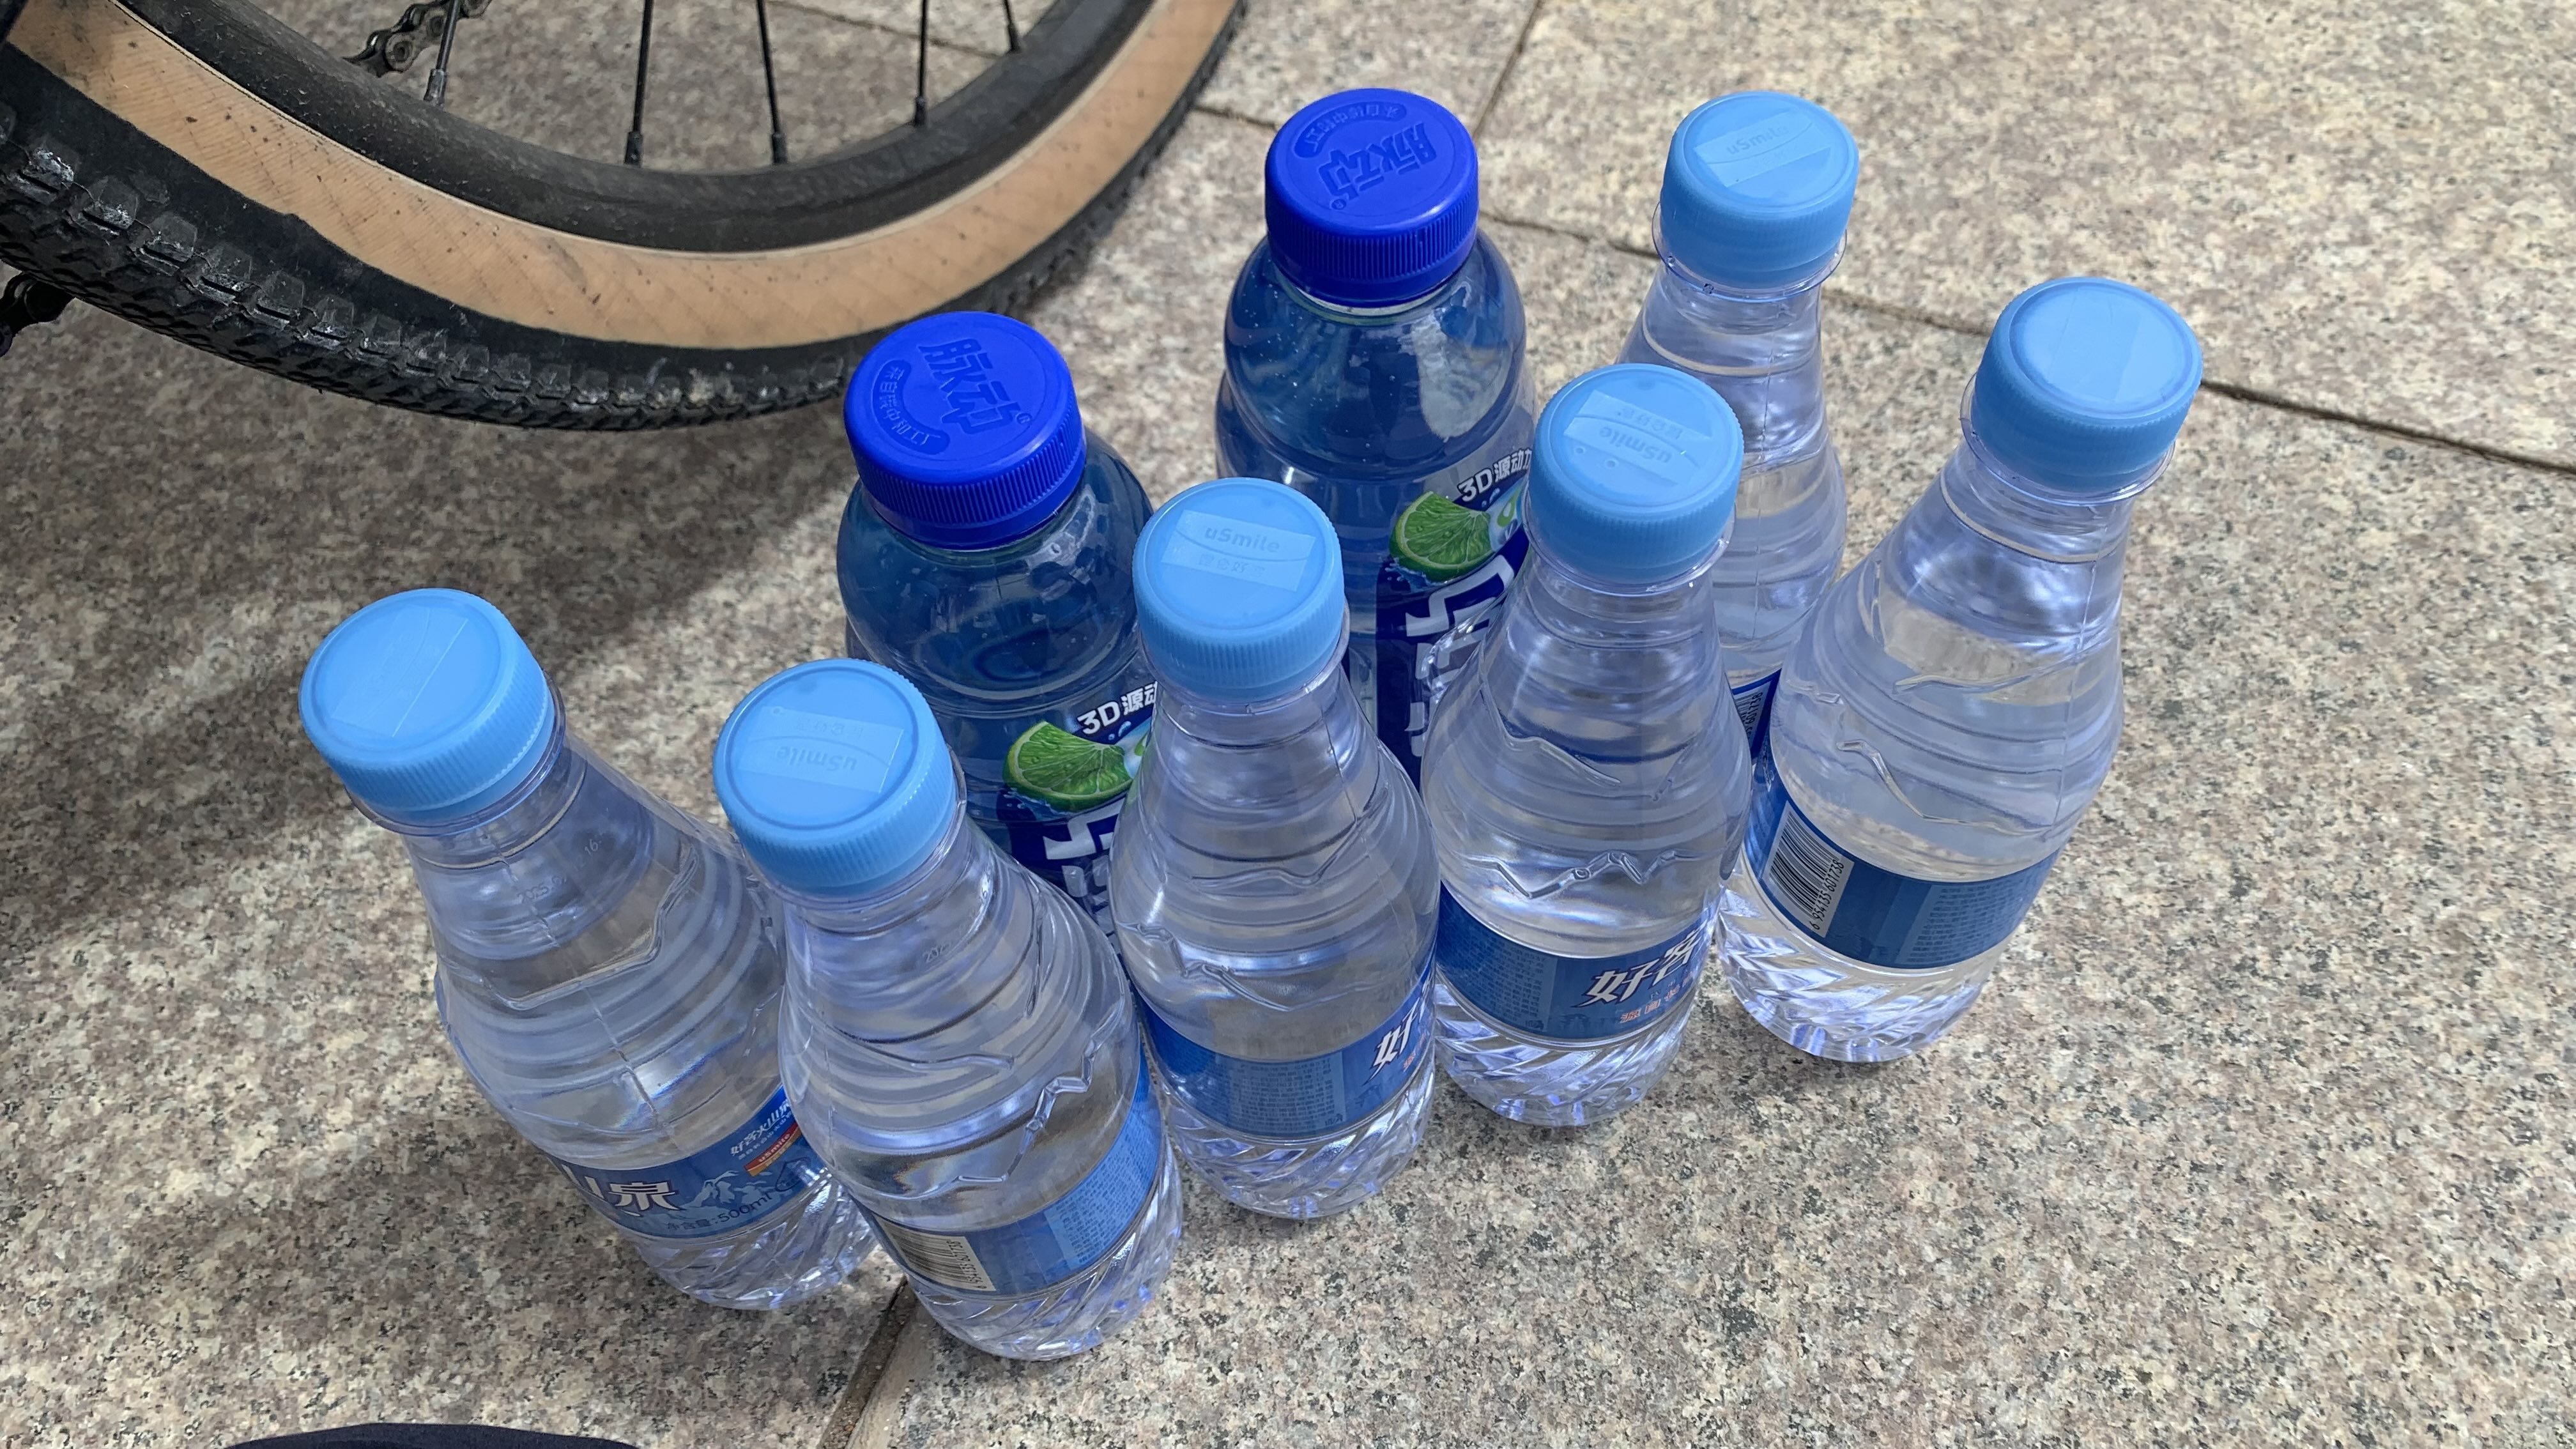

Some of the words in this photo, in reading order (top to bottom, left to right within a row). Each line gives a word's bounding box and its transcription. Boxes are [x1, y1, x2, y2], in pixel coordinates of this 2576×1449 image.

[1318, 122, 1438, 200] 脉动
[917, 339, 1020, 434] 脉动
[1205, 526, 1280, 553] uSmile
[1812, 890, 1832, 921] 954135
[1823, 859, 1844, 892] 601738
